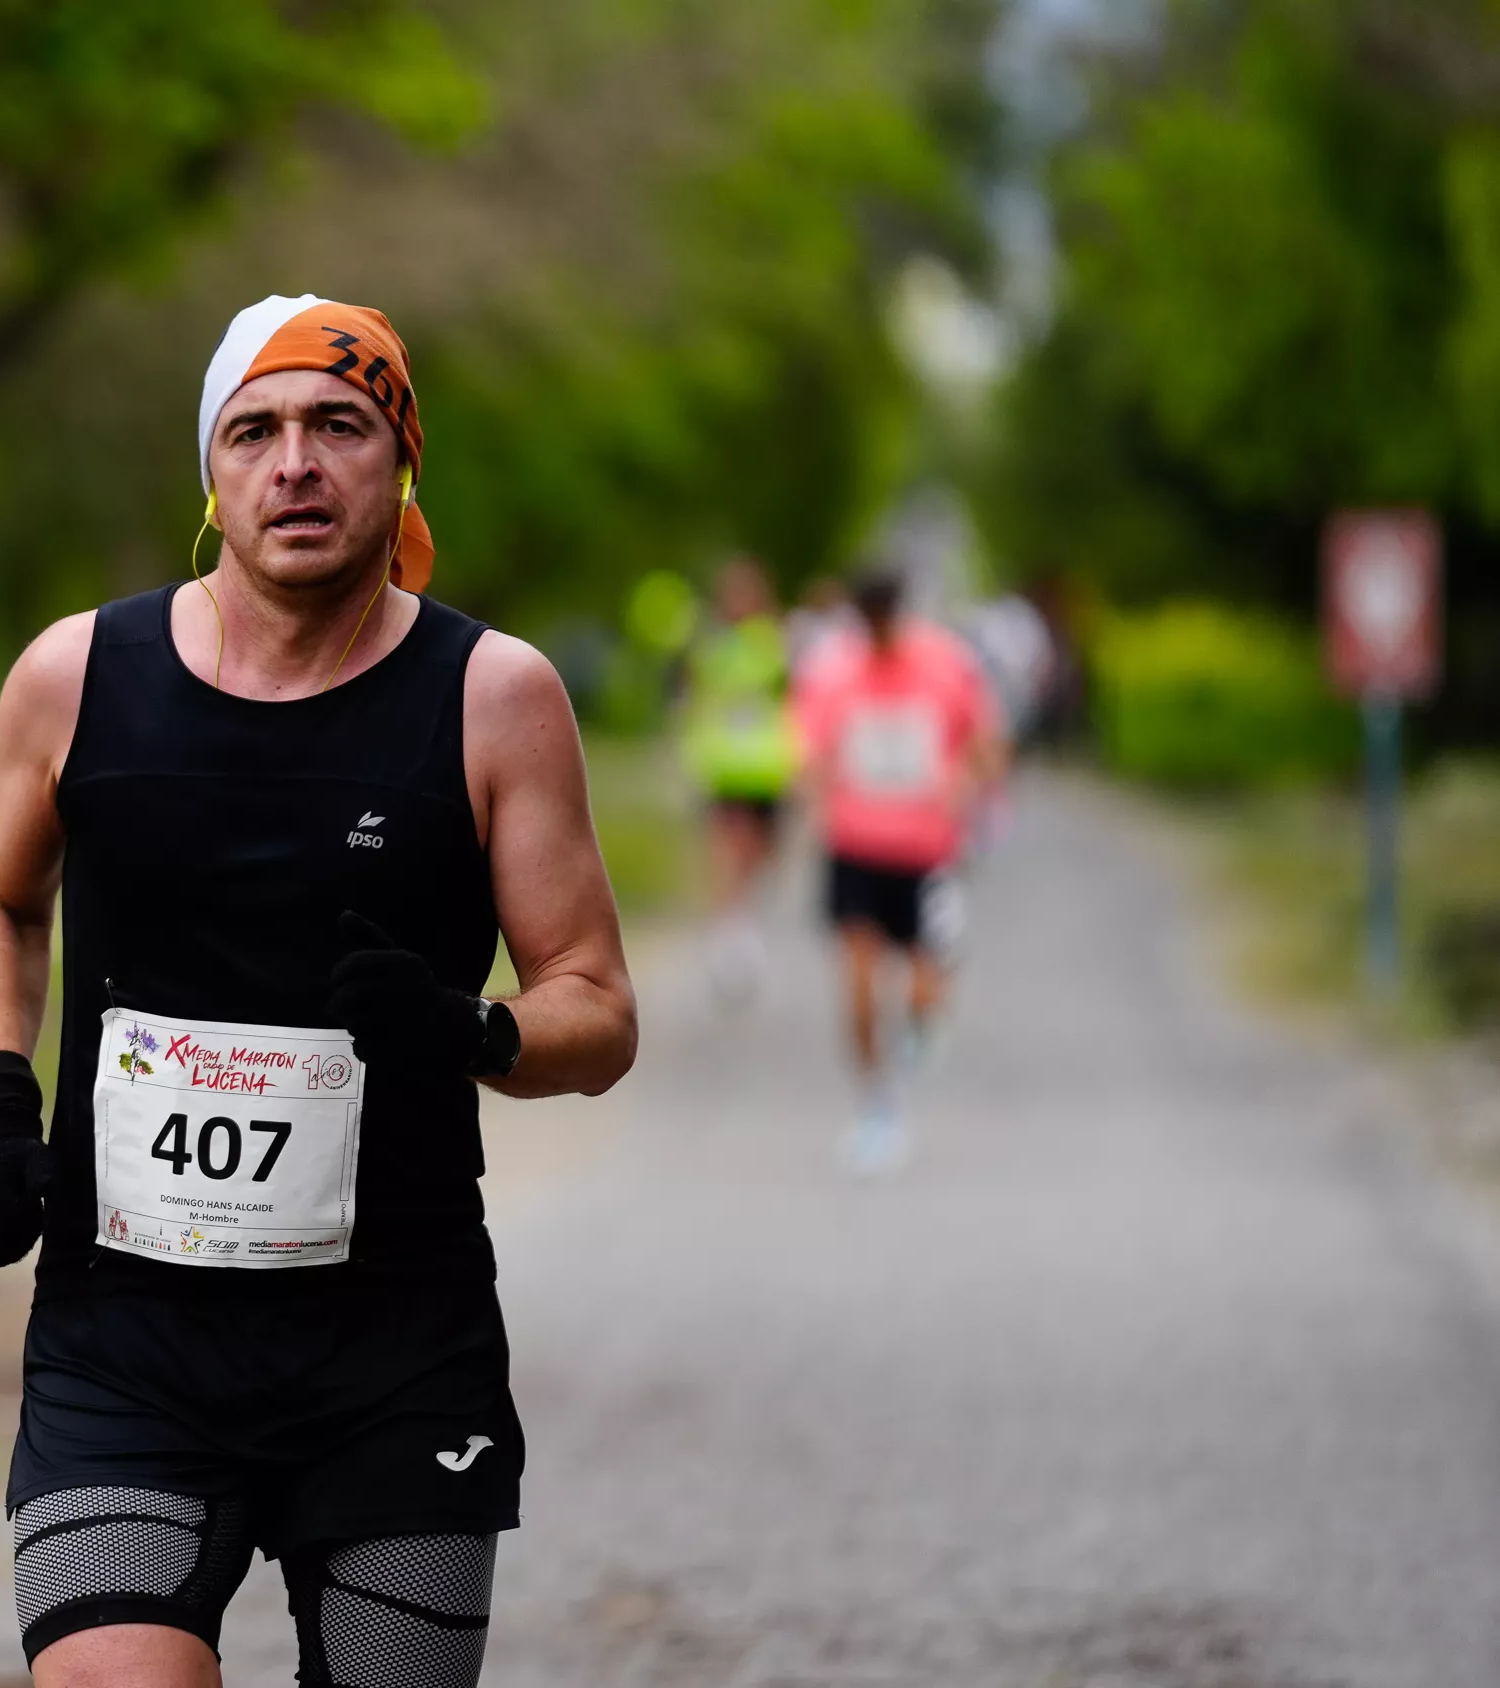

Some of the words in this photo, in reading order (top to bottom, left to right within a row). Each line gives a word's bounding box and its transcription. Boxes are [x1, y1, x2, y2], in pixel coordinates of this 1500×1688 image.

[229, 1046, 297, 1070] MARATÓN
[191, 1064, 279, 1094] LUCENA
[151, 1112, 293, 1182] 407
[160, 1194, 204, 1208] DOMINGO
[206, 1199, 233, 1211] HANS
[234, 1202, 274, 1213] ALCAIDE
[189, 1212, 239, 1224] M-Hombre
[249, 1239, 338, 1248] mediamaratonlucena.com
